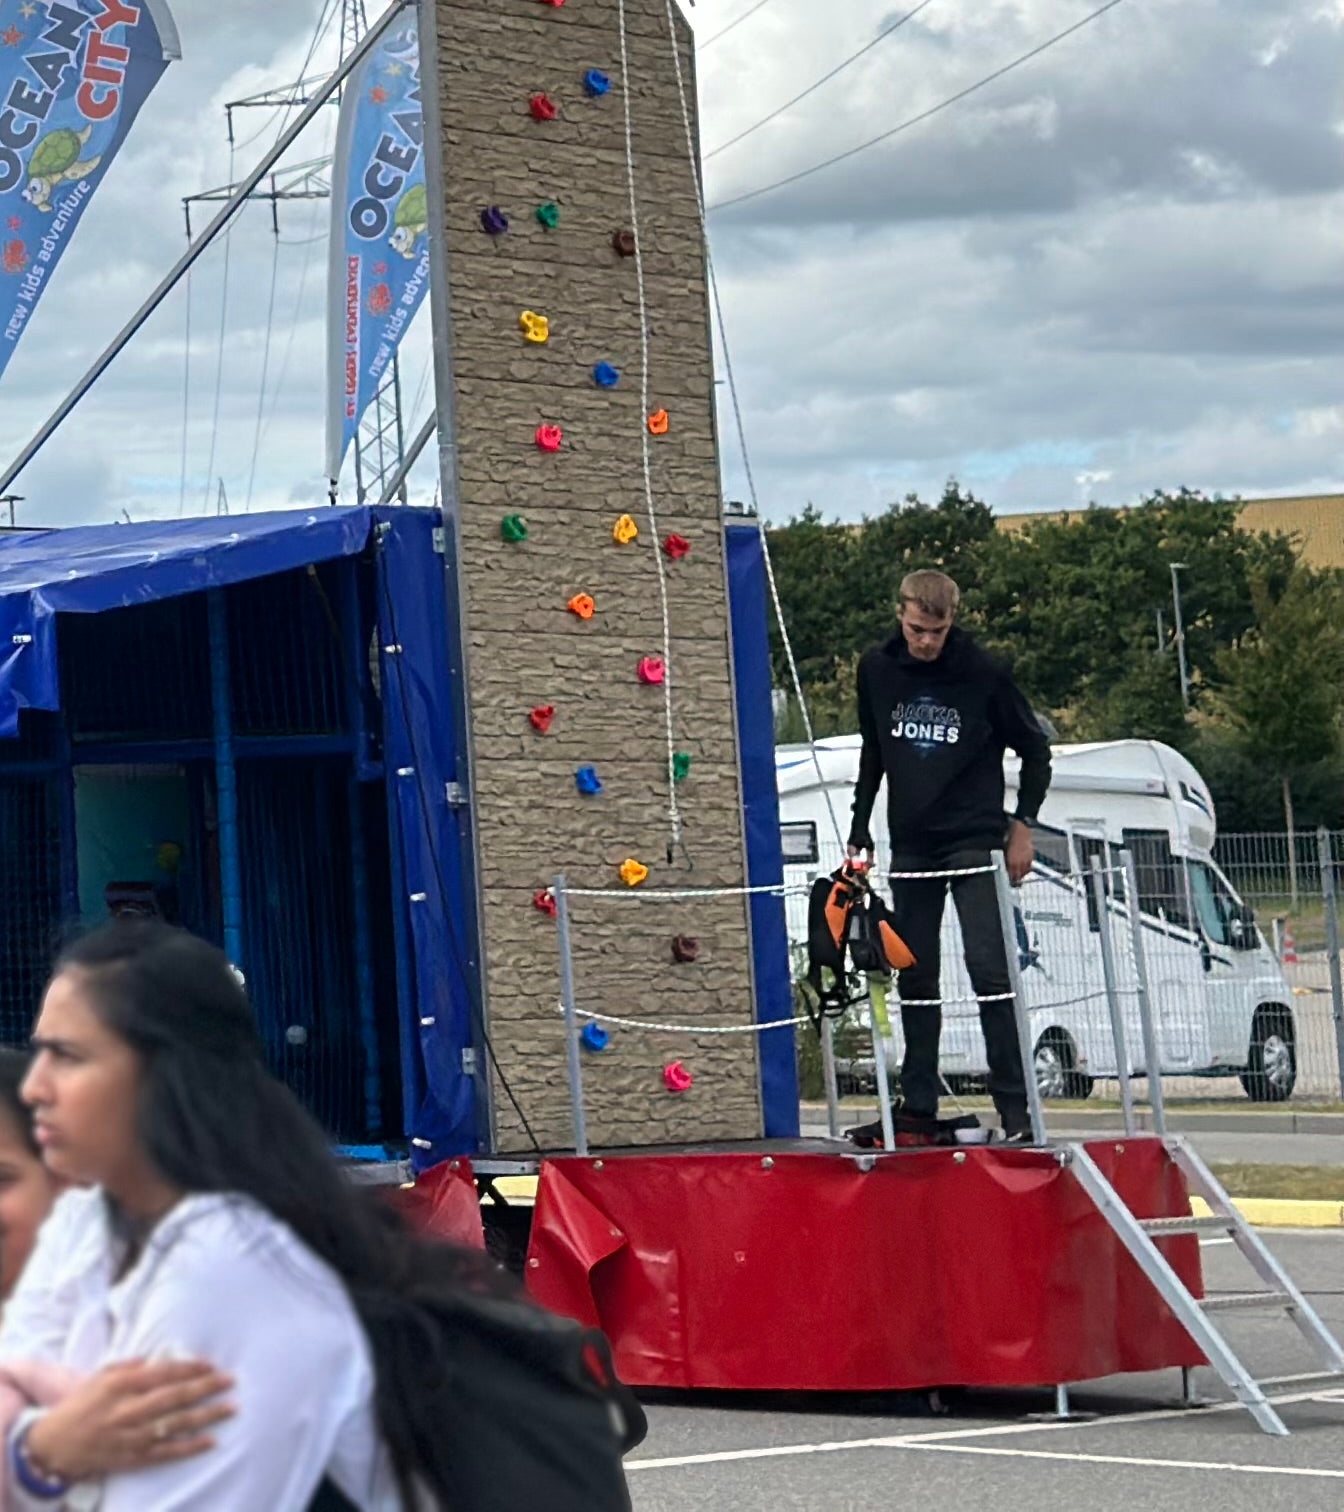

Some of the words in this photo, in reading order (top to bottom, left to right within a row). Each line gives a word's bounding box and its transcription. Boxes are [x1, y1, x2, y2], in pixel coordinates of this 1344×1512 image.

[349, 68, 423, 239] OCEA
[5, 303, 28, 340] new
[18, 264, 45, 303] kids
[38, 179, 91, 262] adventure
[369, 342, 391, 377] new
[383, 307, 408, 341] kids
[891, 721, 959, 744] JONES
